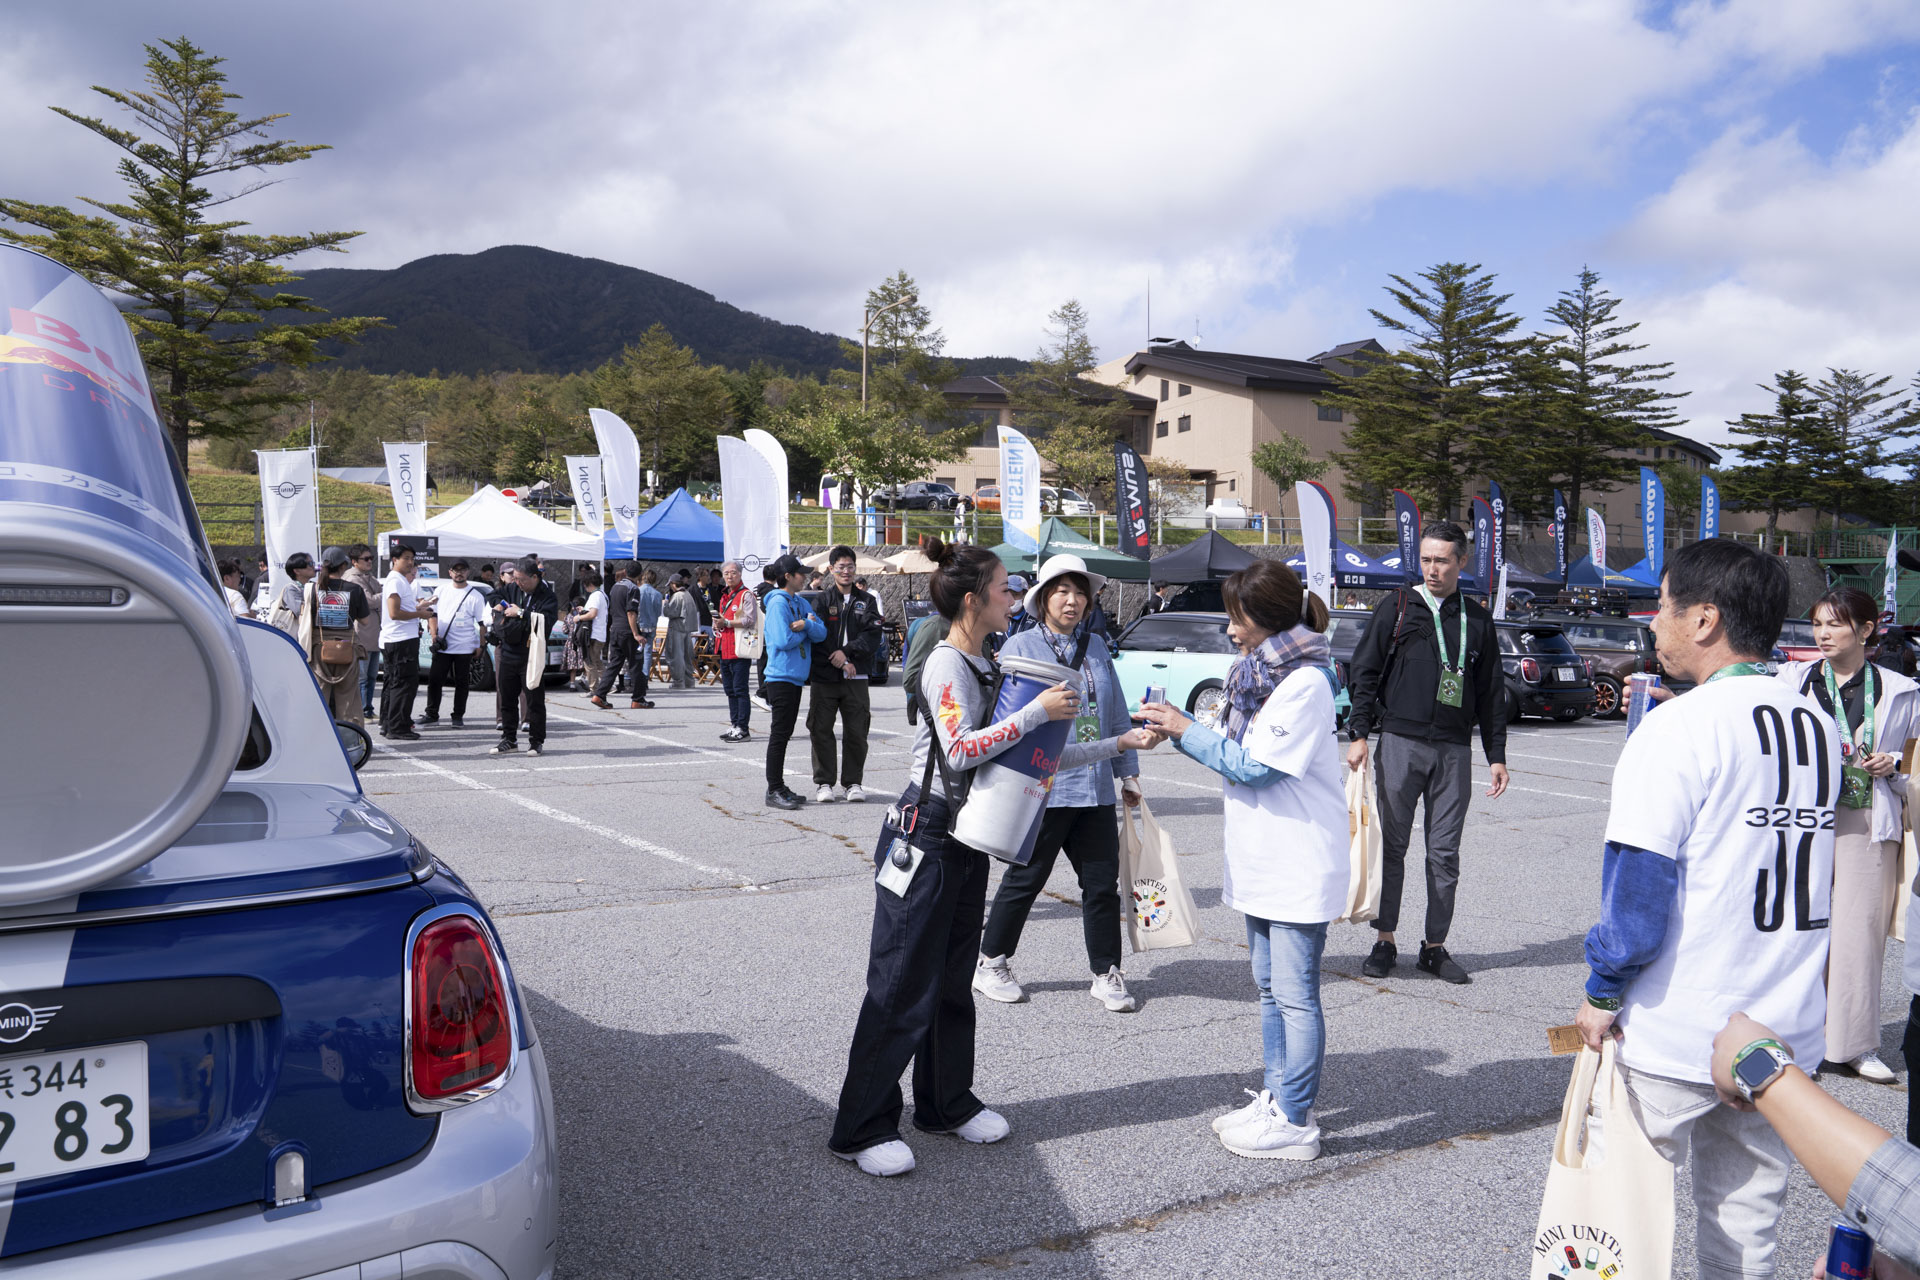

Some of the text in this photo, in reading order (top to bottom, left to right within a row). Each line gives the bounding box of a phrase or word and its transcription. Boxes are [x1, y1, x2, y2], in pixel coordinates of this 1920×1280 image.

[1031, 747, 1061, 774] Red
[1023, 786, 1045, 801] ENERG
[1745, 808, 1835, 830] 3252
[1134, 879, 1168, 895] UNITED.
[0, 1016, 30, 1030] MINI
[21, 1058, 88, 1097] 344
[1534, 1224, 1623, 1266] MINI UNITE
